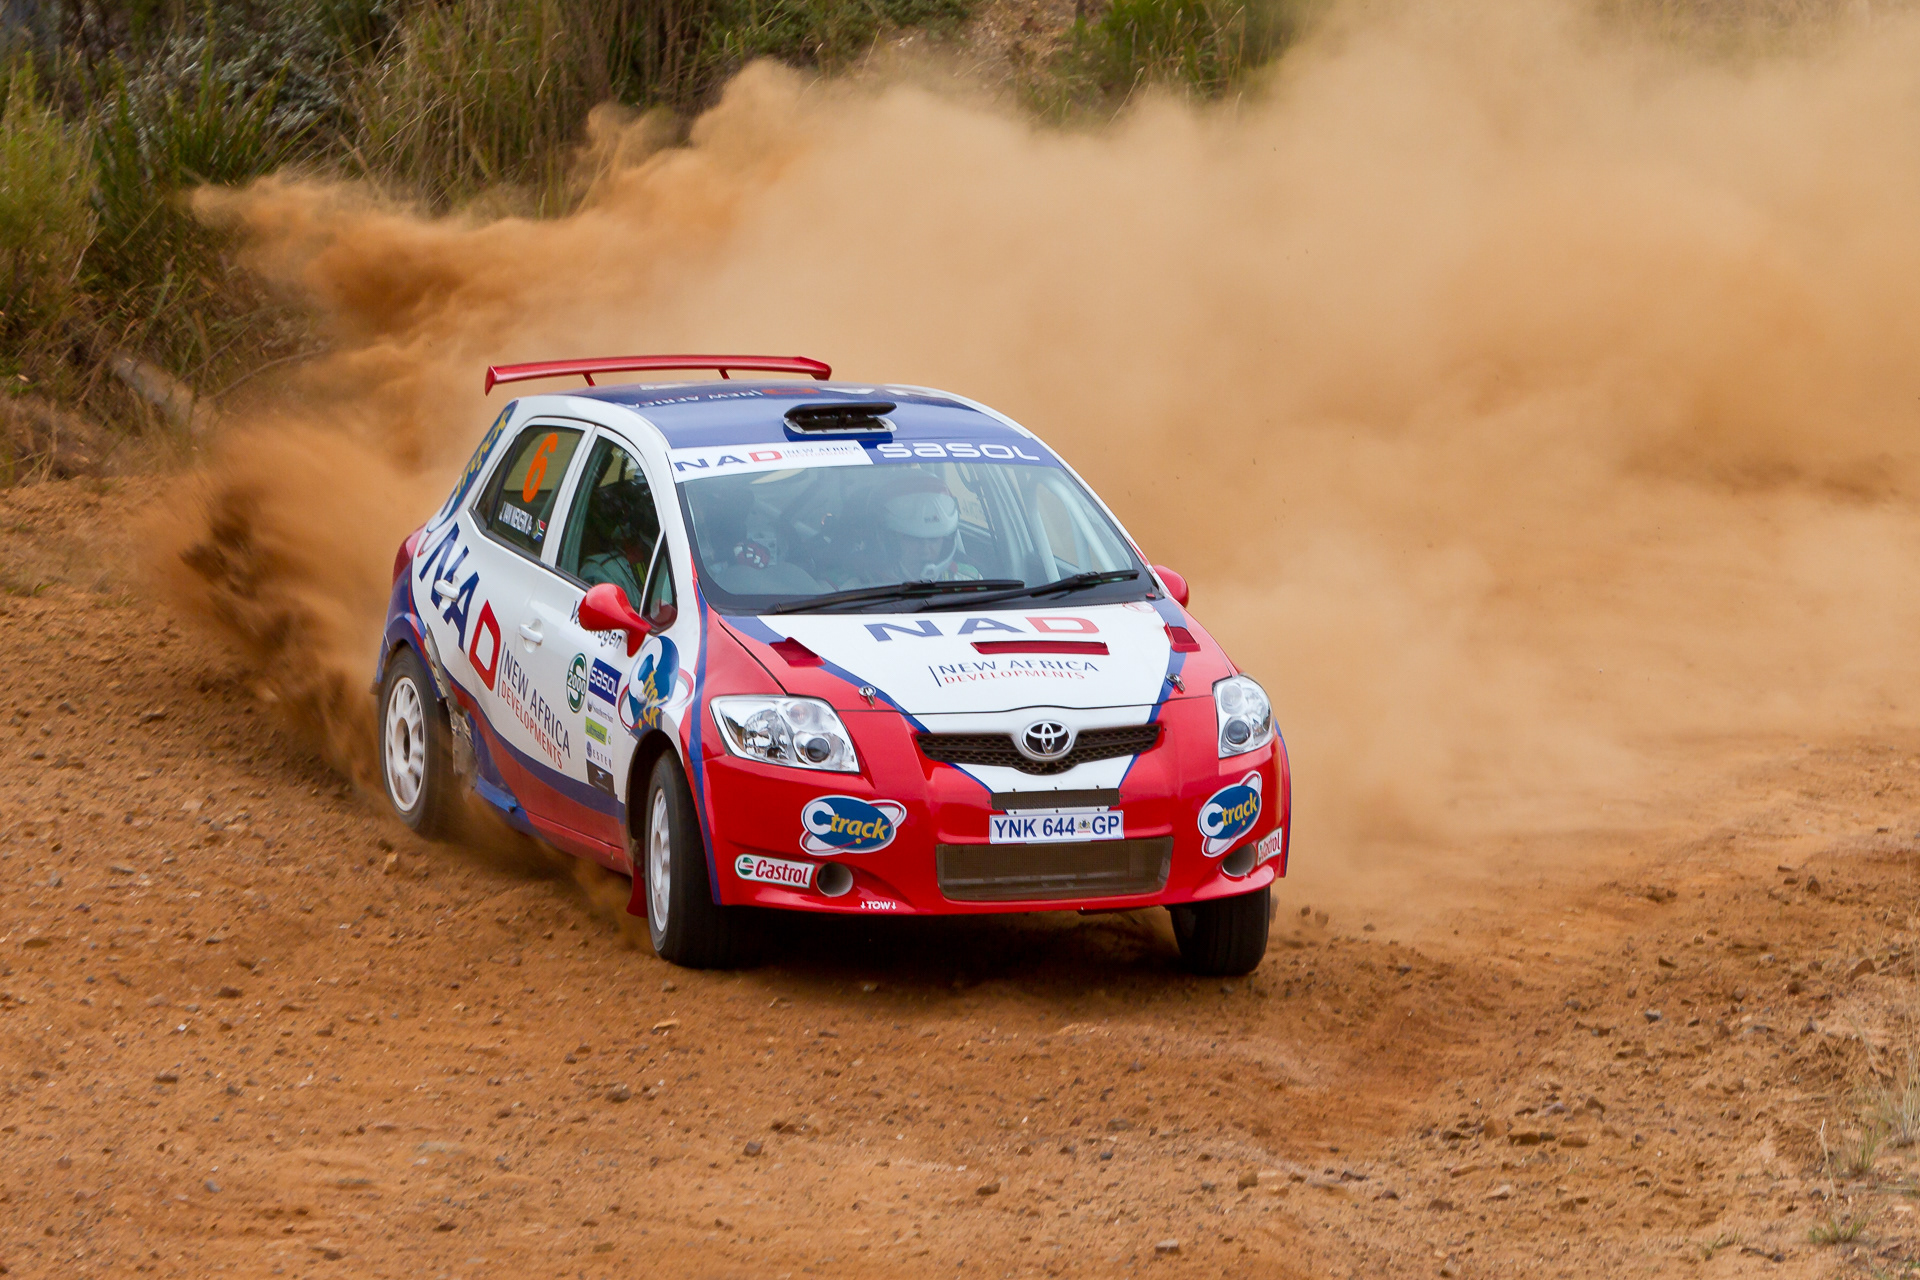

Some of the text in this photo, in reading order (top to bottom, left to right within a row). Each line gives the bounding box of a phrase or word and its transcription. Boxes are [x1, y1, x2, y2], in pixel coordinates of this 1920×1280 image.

[522, 432, 559, 503] 6
[674, 450, 783, 473] NAD
[419, 522, 501, 692] NAD
[864, 616, 1100, 642] NAD
[938, 659, 1100, 675] NEW AFRICA
[943, 670, 1085, 685] DEVELOPMENTS
[568, 671, 586, 697] 2000
[504, 649, 571, 759] NEW AFRICA
[502, 680, 562, 770] DEVELOPMENTS
[804, 801, 888, 842] Ctrack
[994, 815, 1120, 839] YNK 644 GP
[1200, 792, 1258, 837] Ctrack
[755, 859, 809, 886] Castrol
[867, 901, 891, 910] TOW
